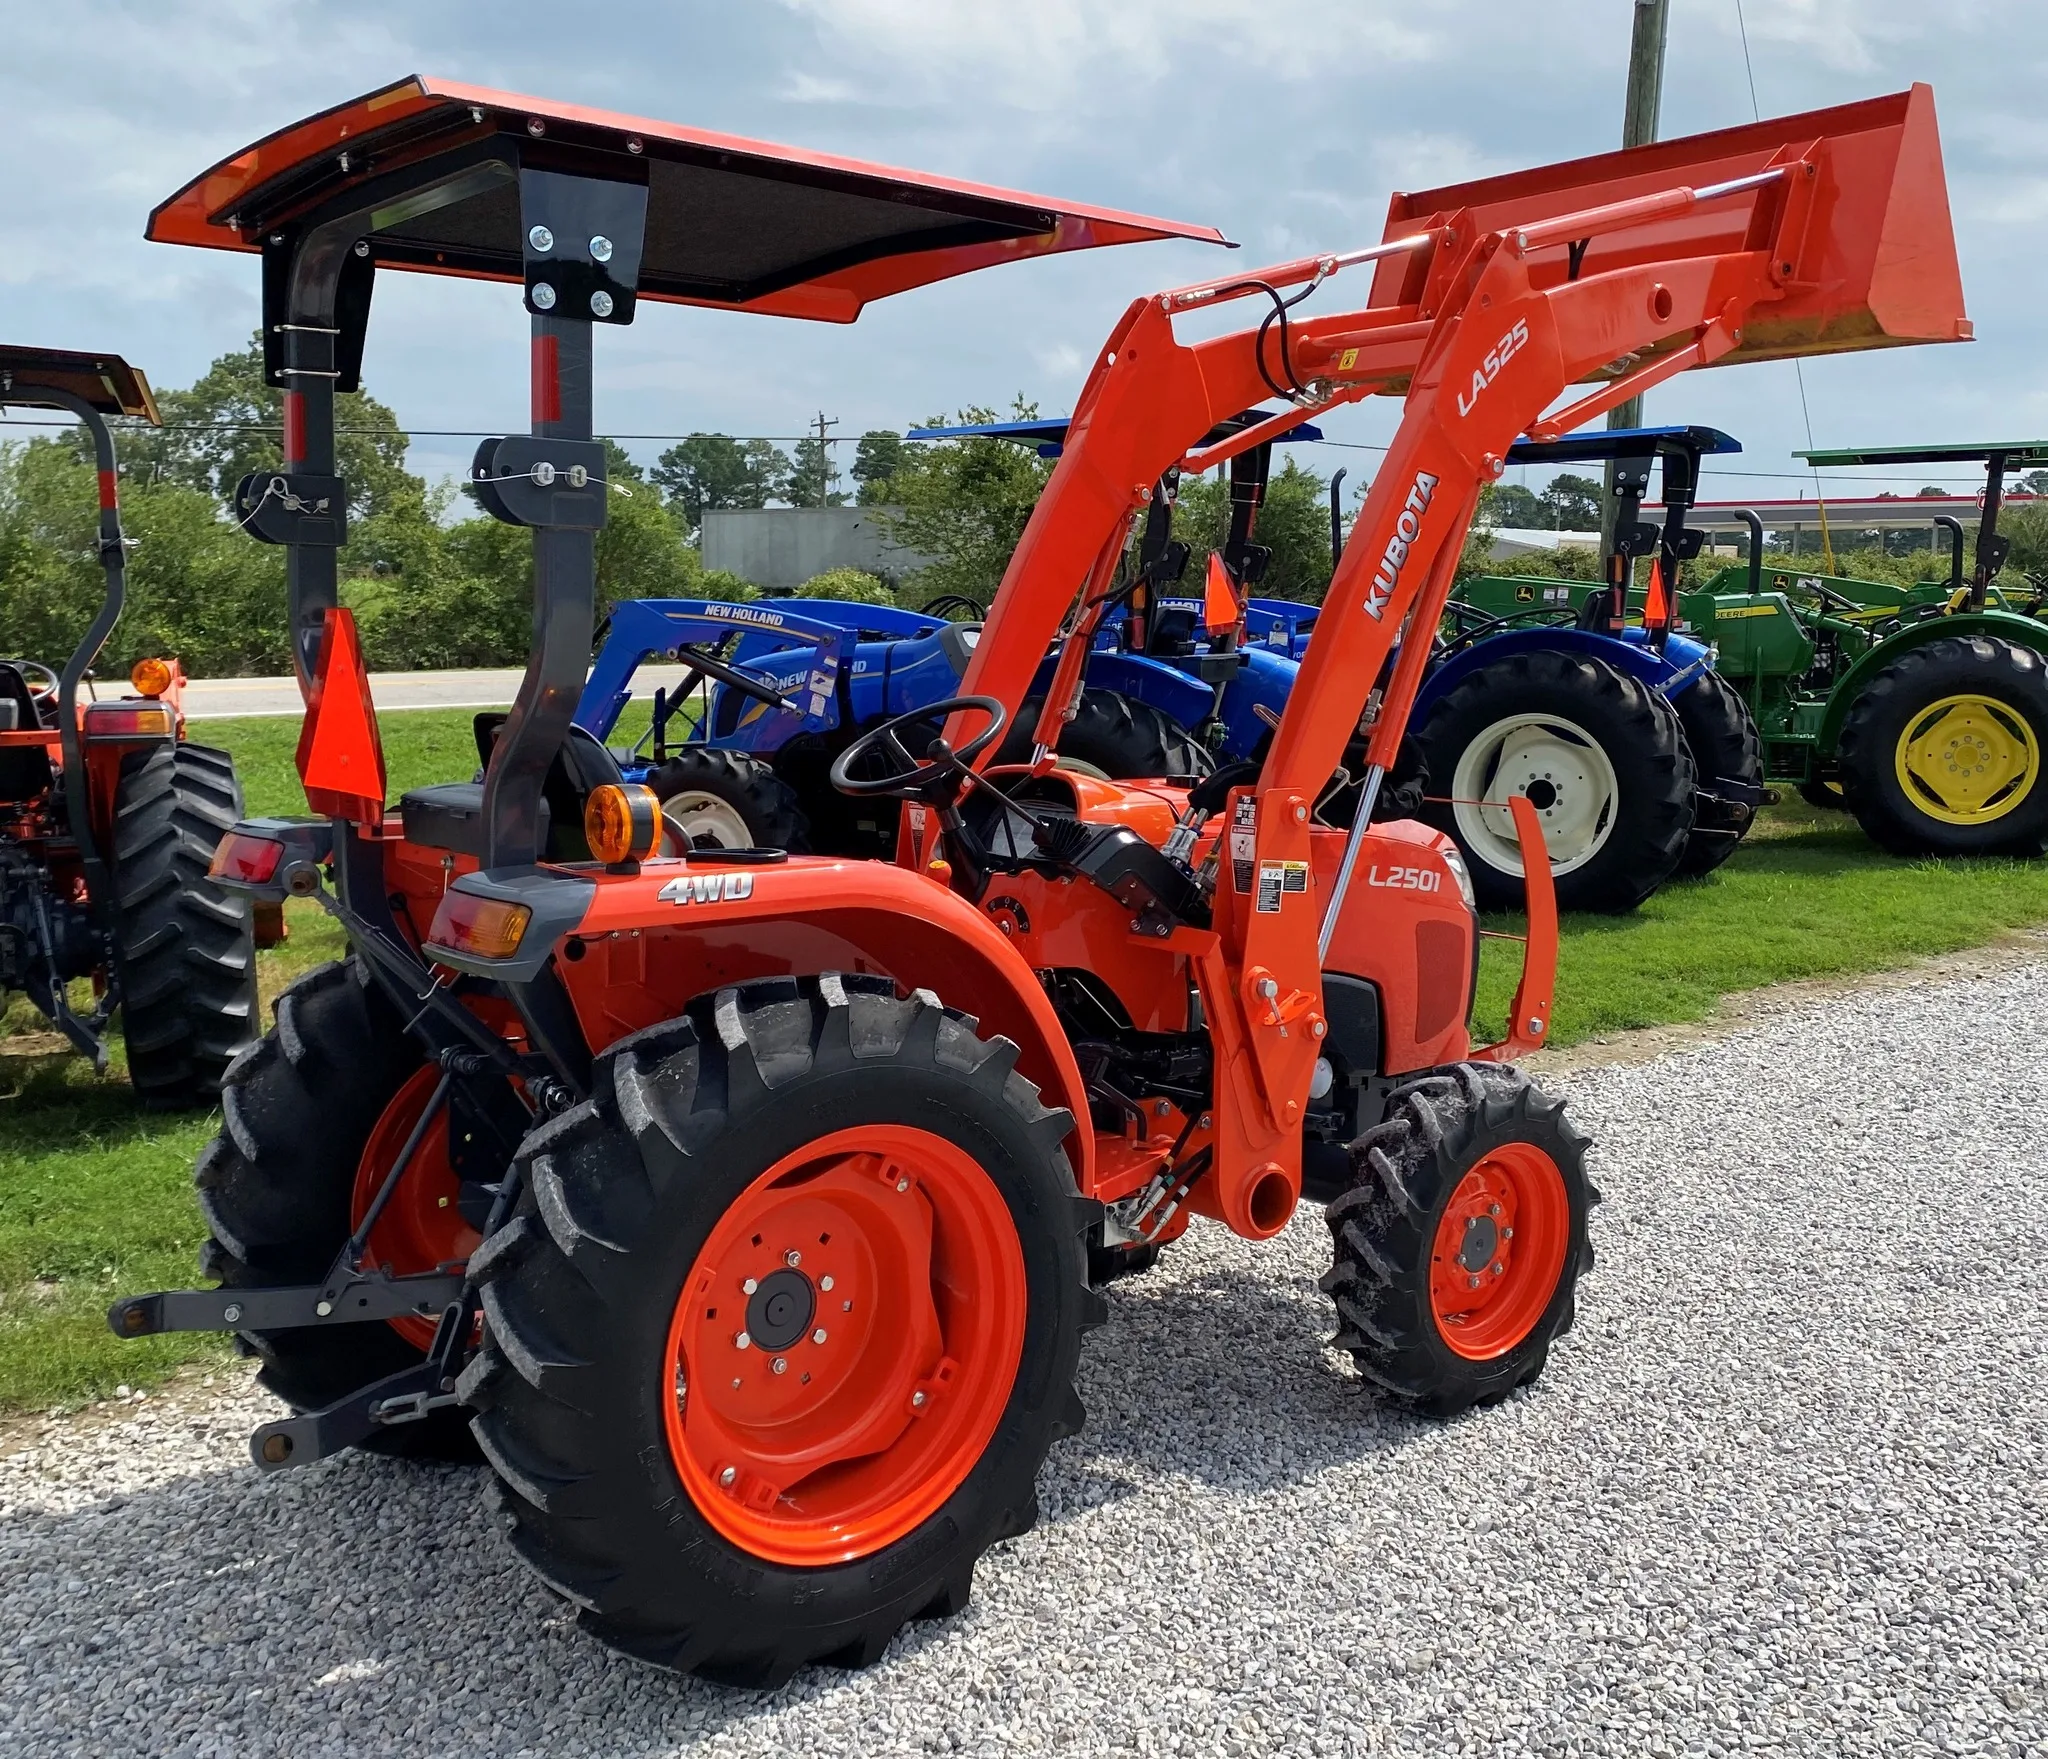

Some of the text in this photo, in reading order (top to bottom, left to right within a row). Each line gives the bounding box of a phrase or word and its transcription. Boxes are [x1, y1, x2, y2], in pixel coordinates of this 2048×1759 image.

[1457, 317, 1529, 417] LA525
[1363, 470, 1440, 623] KUBOTA
[704, 604, 784, 626] NEW HOLLAND
[778, 670, 808, 690] NEW
[657, 872, 755, 906] 4WD
[1368, 865, 1442, 893] L2501
